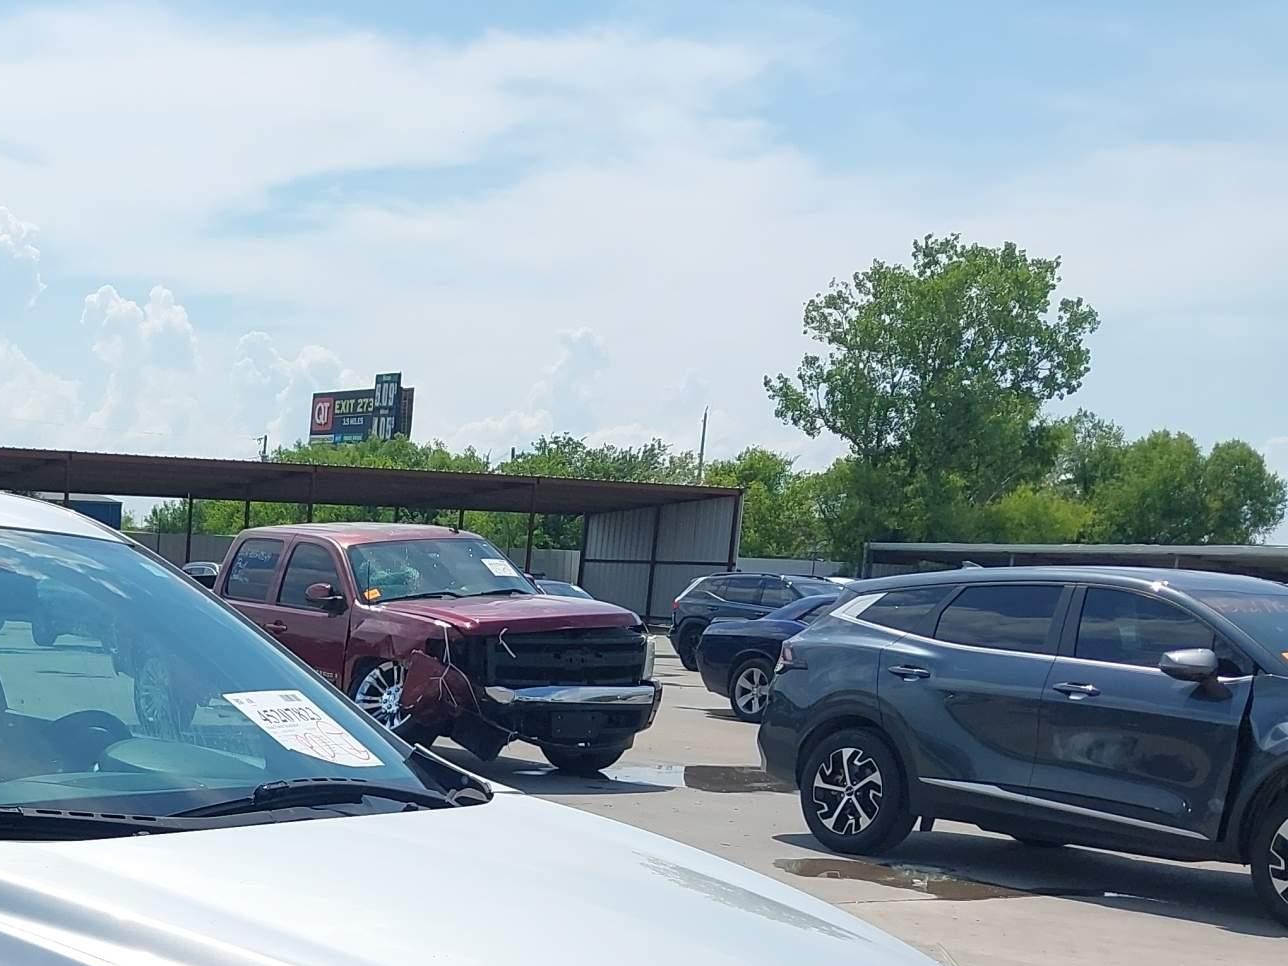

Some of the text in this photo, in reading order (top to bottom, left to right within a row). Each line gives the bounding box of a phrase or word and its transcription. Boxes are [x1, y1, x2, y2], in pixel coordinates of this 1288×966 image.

[315, 402, 330, 425] QT
[335, 400, 355, 414] EXIT
[356, 398, 374, 412] 273
[256, 706, 322, 724] 45207823
